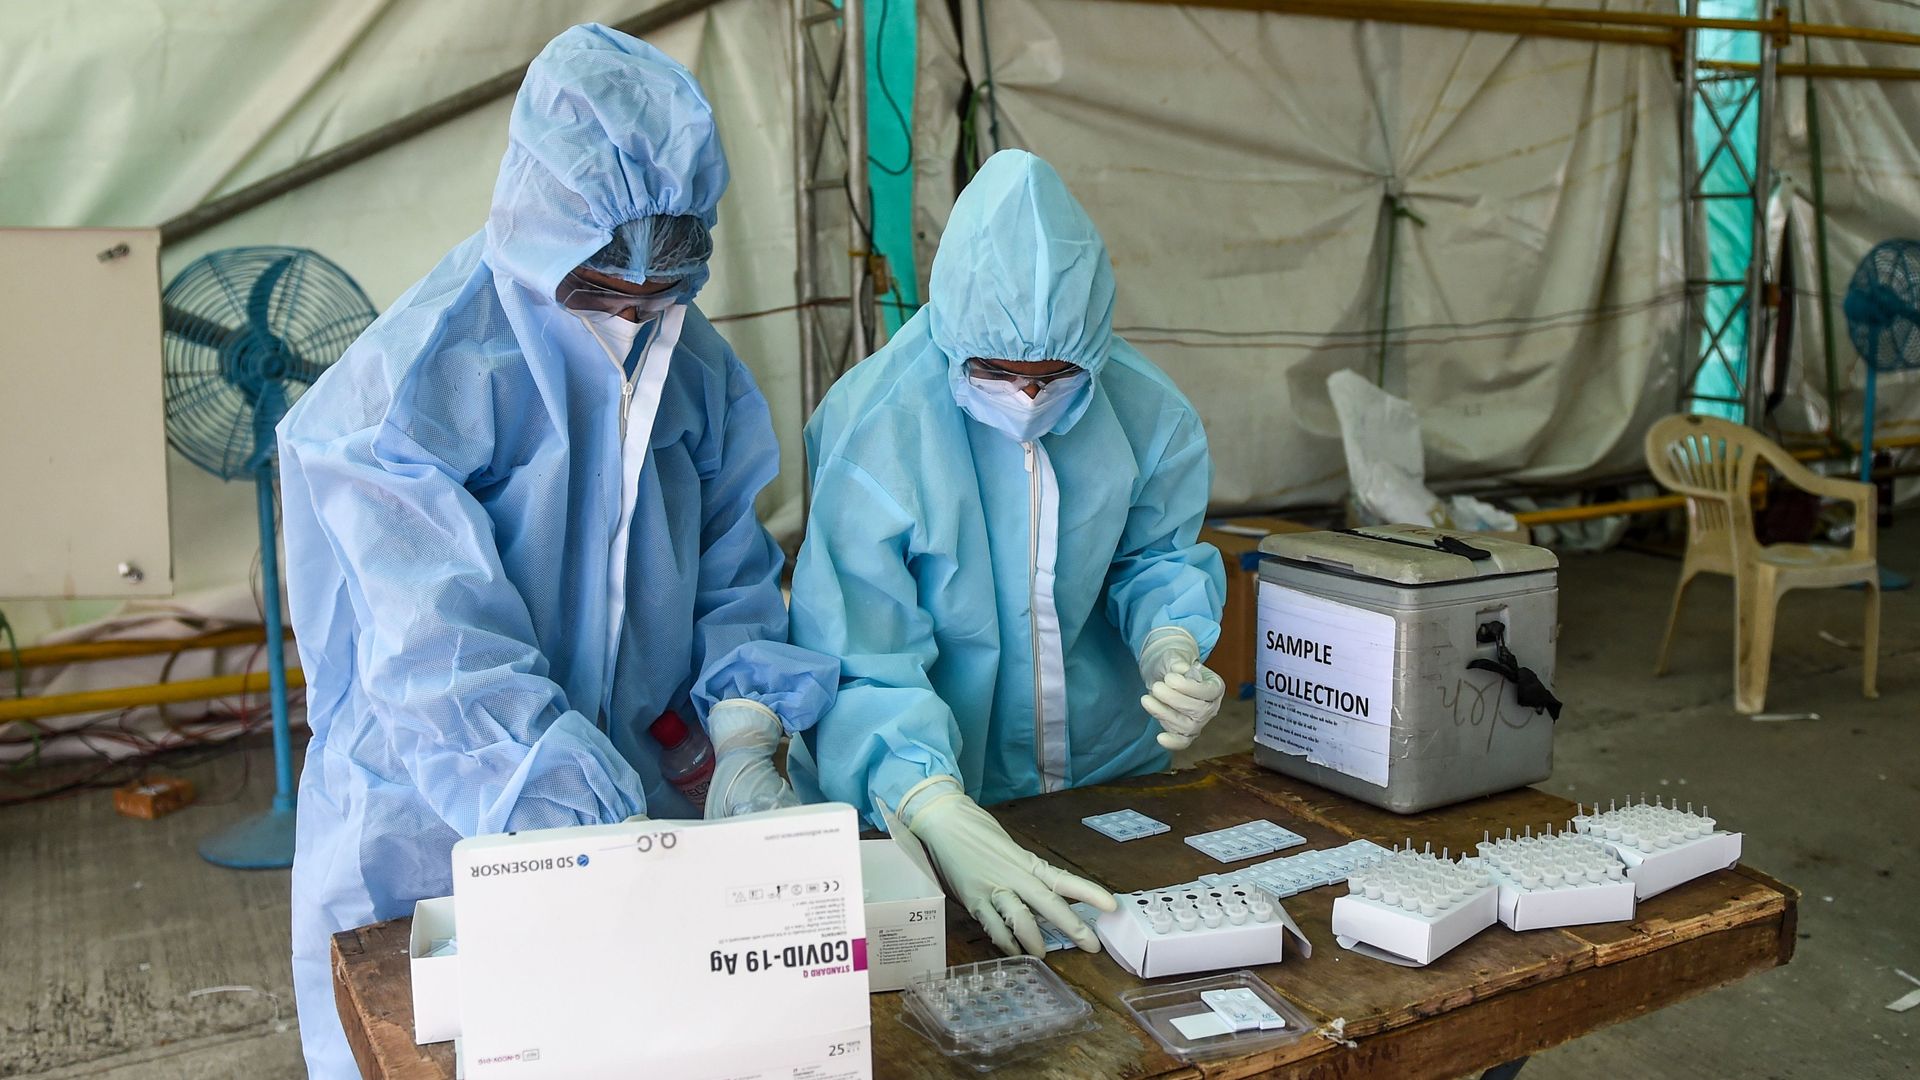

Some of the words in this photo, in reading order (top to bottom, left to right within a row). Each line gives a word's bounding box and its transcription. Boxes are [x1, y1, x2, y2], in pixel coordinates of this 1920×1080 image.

[1266, 630, 1332, 665] SAMPLE
[1265, 670, 1369, 717] COLLECTION
[636, 831, 677, 853] Q.C
[471, 858, 553, 878] BIOSENSOR
[556, 856, 574, 868] SD
[909, 911, 923, 922] 25
[710, 950, 738, 975] Ag
[746, 940, 849, 972] COVID-19
[803, 970, 809, 978] Q
[811, 965, 850, 977] STANDARD
[828, 1043, 845, 1057] 25
